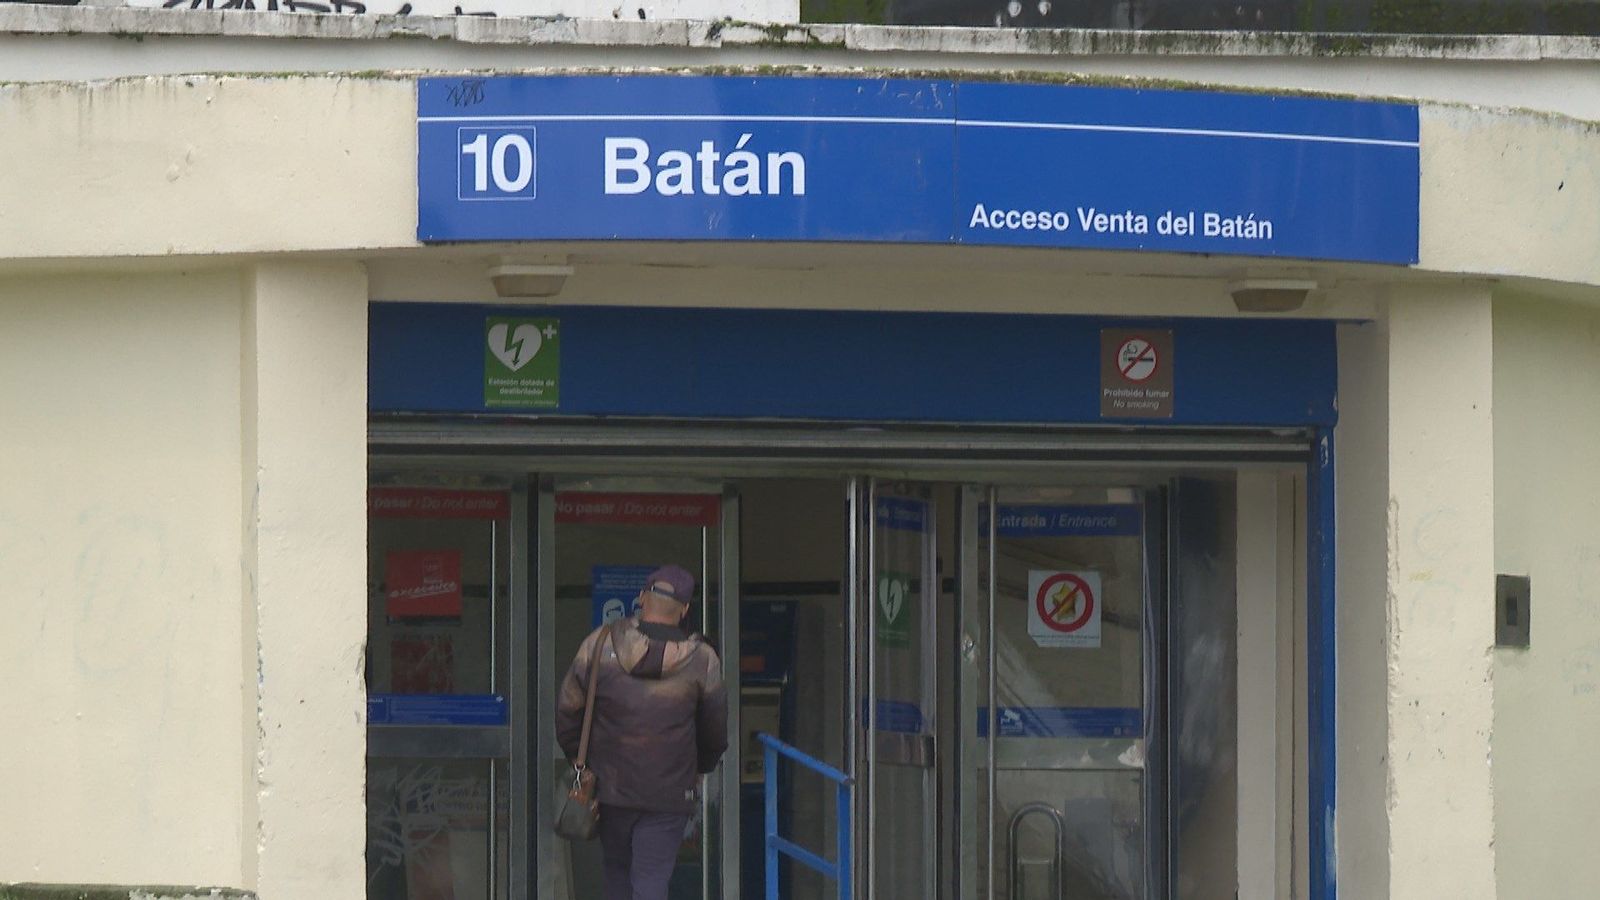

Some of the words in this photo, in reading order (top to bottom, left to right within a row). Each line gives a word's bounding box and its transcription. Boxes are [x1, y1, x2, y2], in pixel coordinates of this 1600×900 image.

[462, 134, 532, 192] 10
[605, 133, 805, 196] Batán
[969, 203, 1069, 231] Acceso
[1077, 207, 1148, 234] Venta
[1157, 211, 1194, 236] del
[1204, 212, 1272, 239] Batán
[1104, 388, 1143, 398] Prohibido
[1145, 389, 1169, 398] fumar
[1113, 400, 1125, 408] No
[1127, 400, 1159, 410] smoking
[575, 503, 615, 516] pasar
[624, 502, 643, 514] Do
[1059, 514, 1117, 527] Entrance
